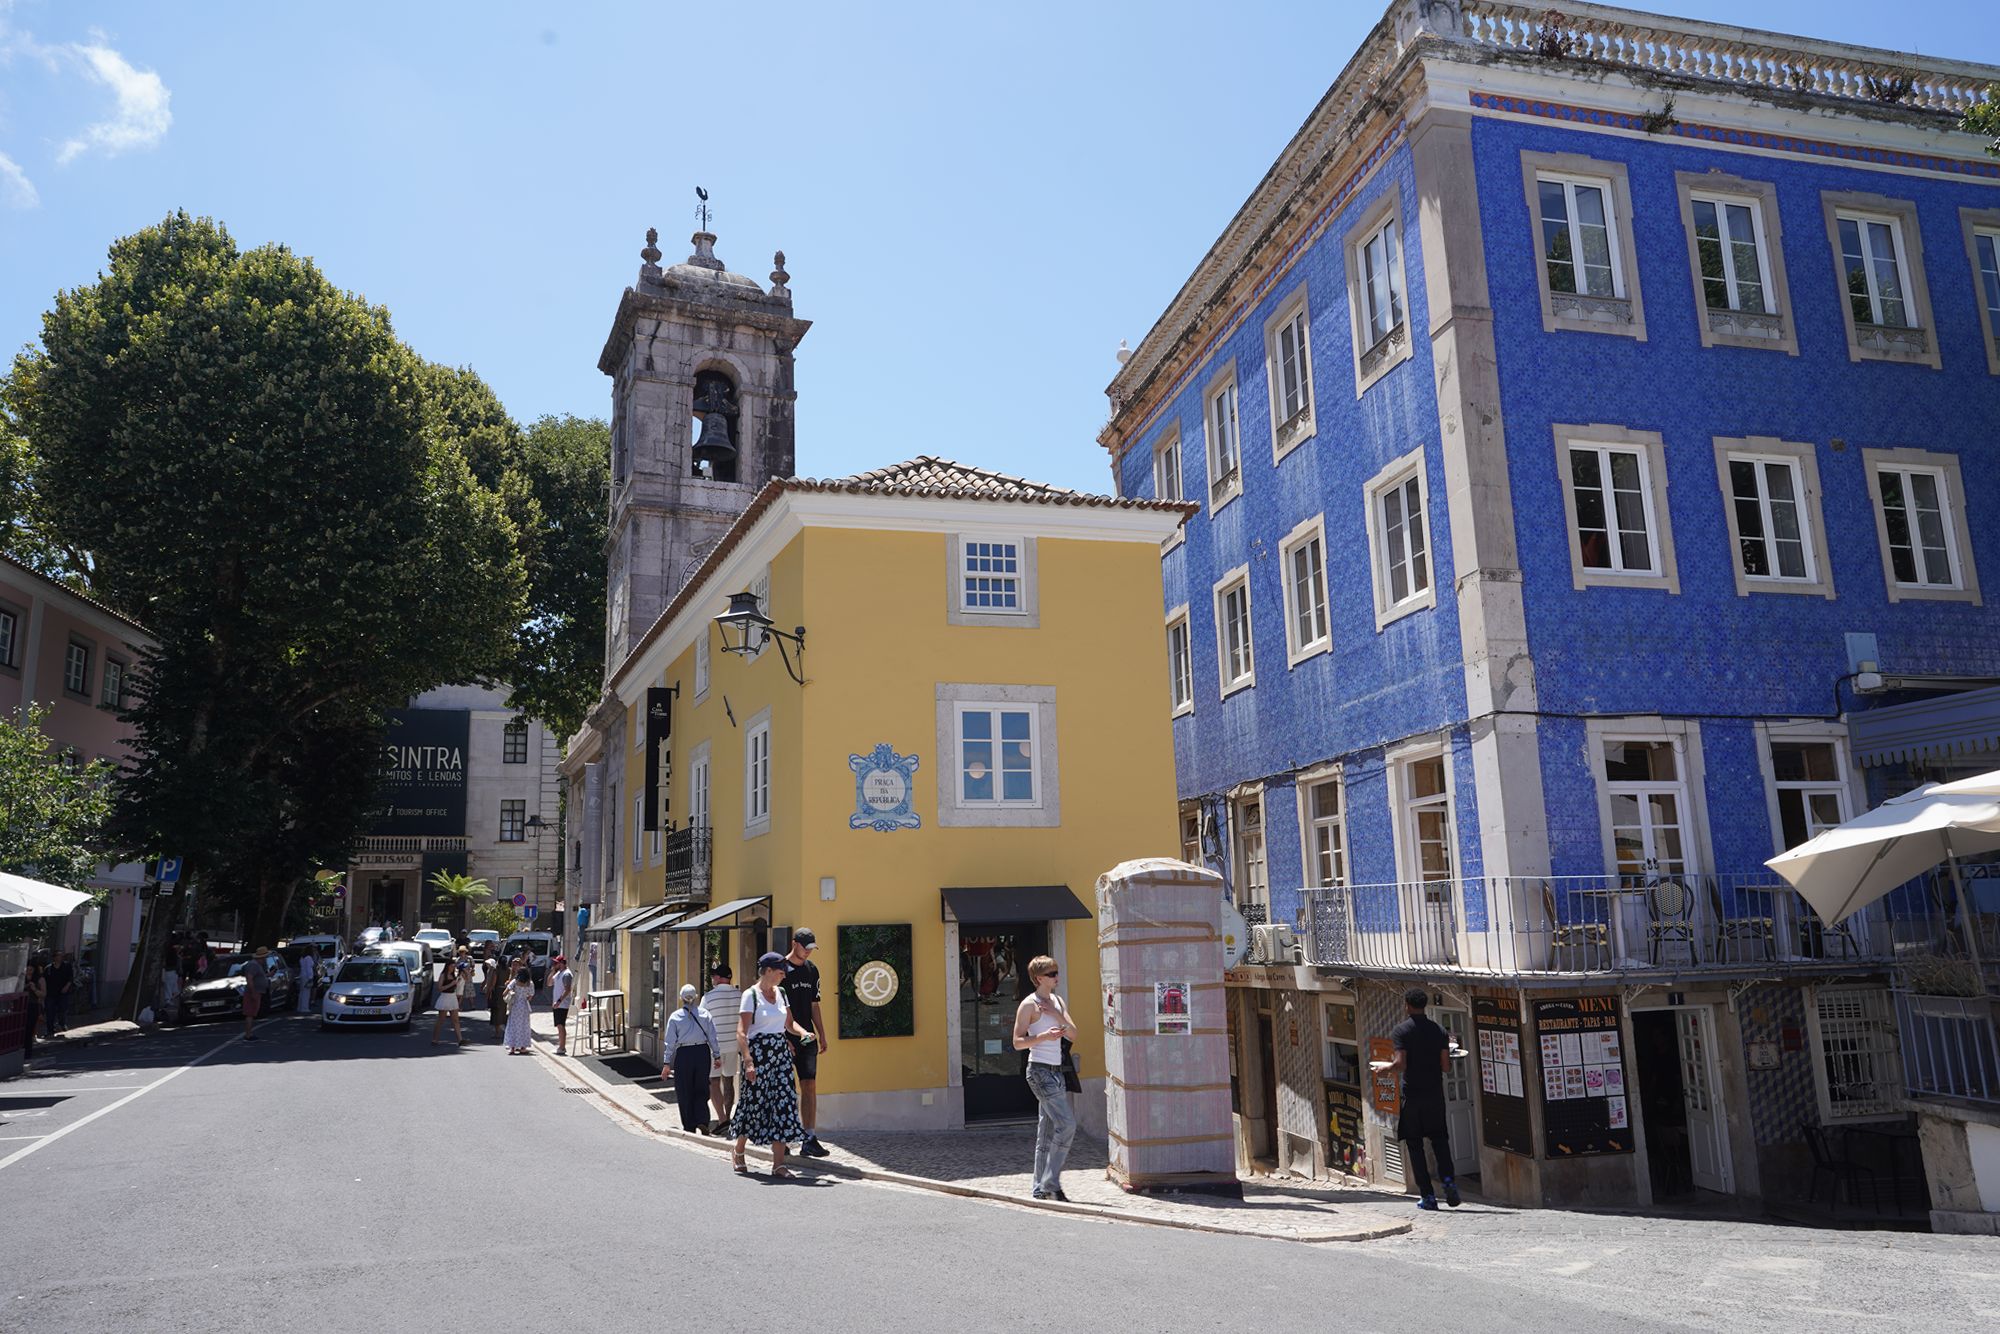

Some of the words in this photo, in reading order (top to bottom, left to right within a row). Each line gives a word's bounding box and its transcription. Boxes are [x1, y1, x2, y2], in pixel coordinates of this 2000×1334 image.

[387, 745, 462, 770] SINTRA
[386, 770, 412, 781] MITOS
[417, 771, 423, 780] E
[429, 771, 462, 781] LENDAS
[874, 778, 894, 787] PRAÇA
[868, 795, 901, 804] REPÚBLICA
[396, 808, 423, 816] TOURISM
[425, 808, 448, 816] OFFICE
[358, 855, 414, 864] TURISMO
[161, 859, 177, 879] P
[1578, 996, 1617, 1012] MENU
[1538, 1017, 1579, 1031] RESTAURANTE
[1583, 1016, 1601, 1028] TAPAS
[1605, 1015, 1617, 1027] BAR
